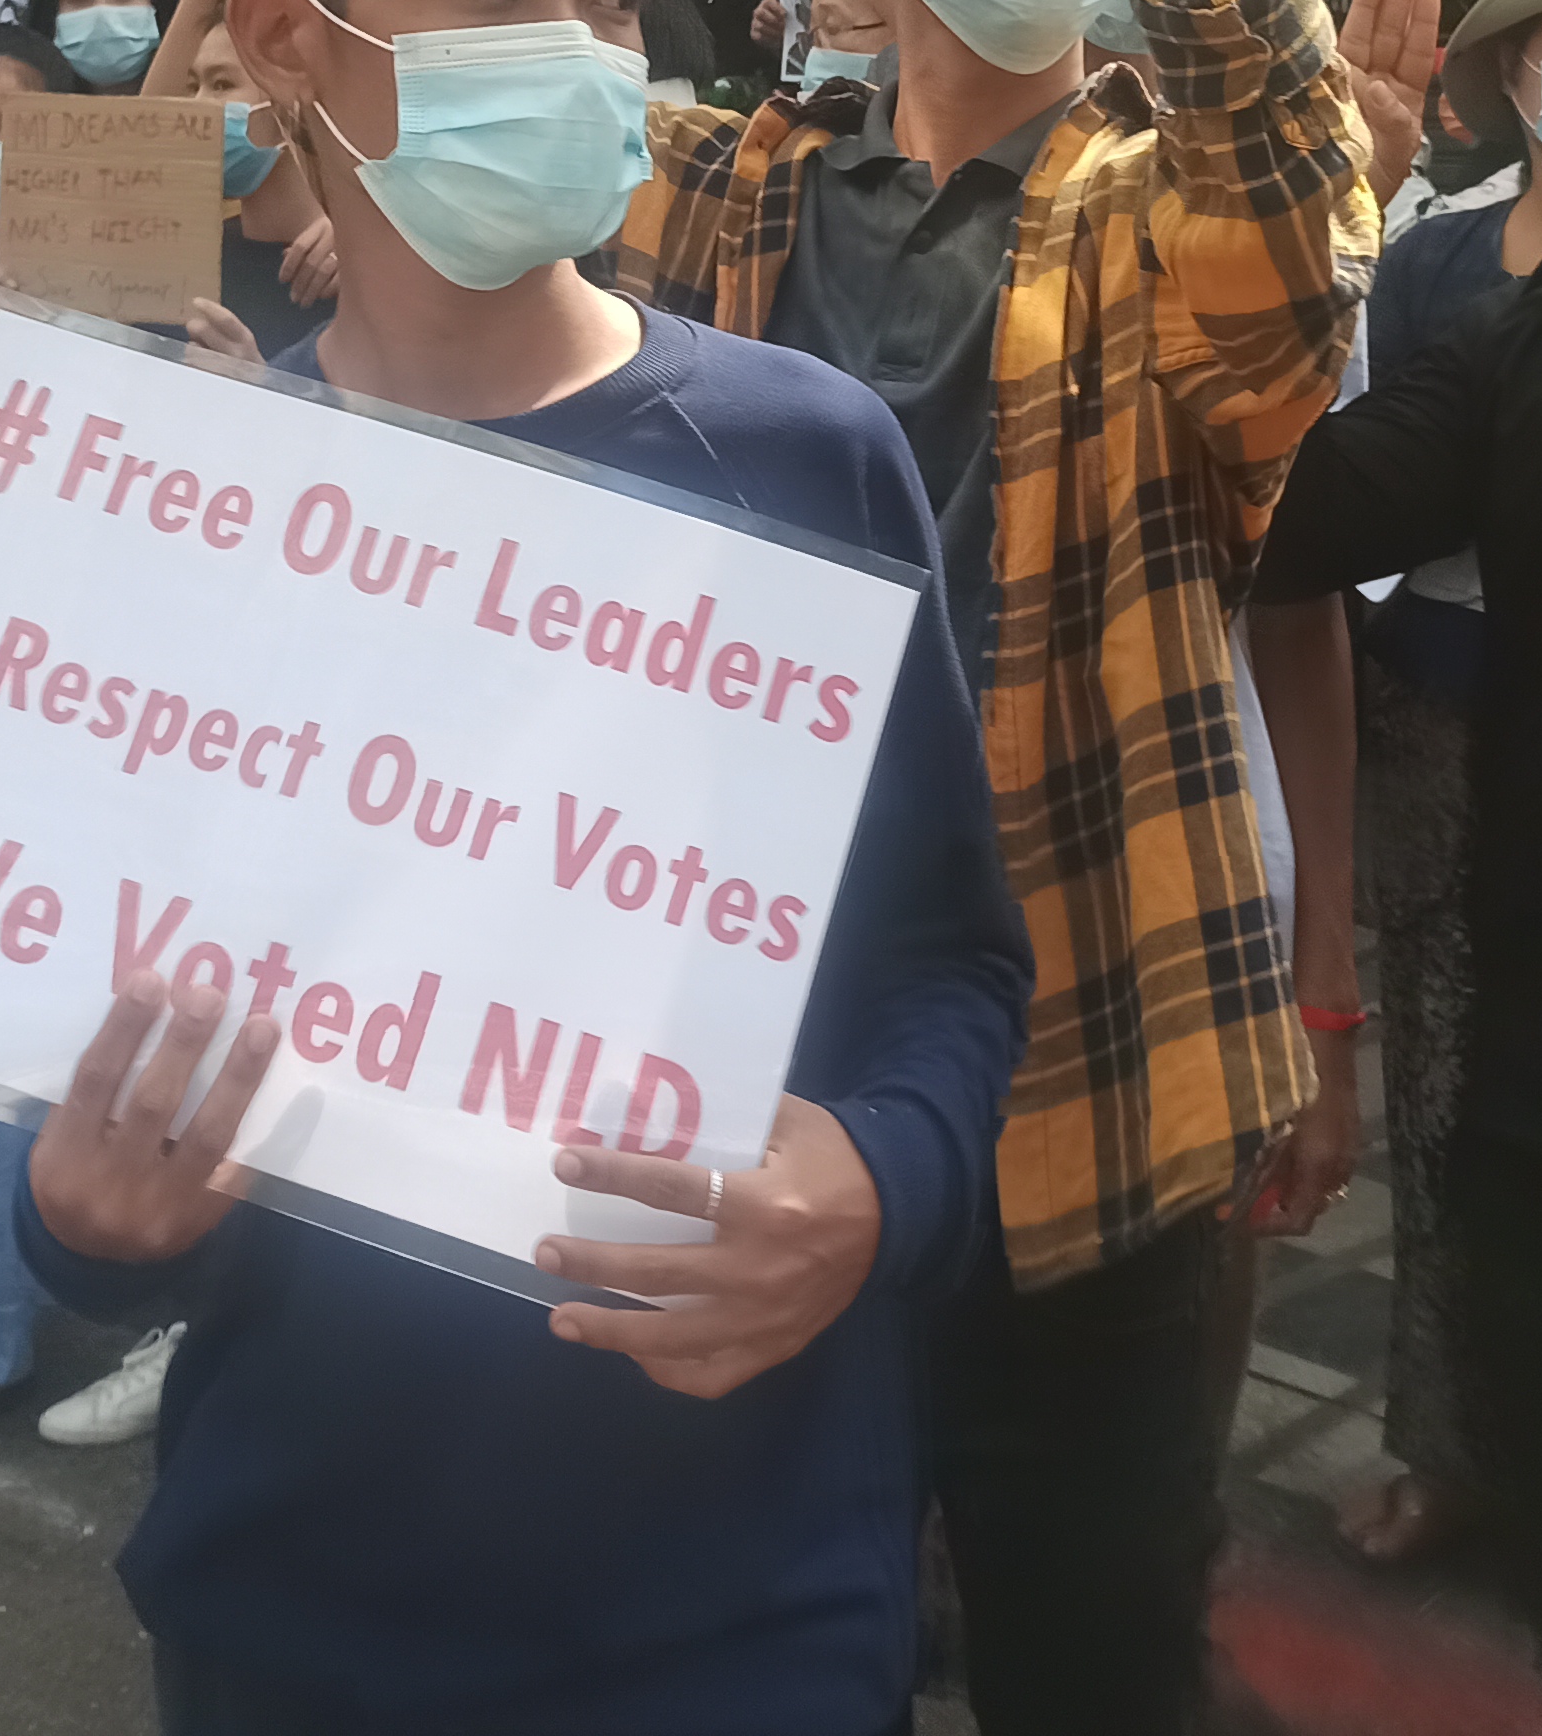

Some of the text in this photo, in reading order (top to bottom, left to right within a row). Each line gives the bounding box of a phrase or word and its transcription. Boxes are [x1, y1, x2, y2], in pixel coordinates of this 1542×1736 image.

[4, 166, 163, 199] HIGHER THAN
[10, 111, 214, 151] MY DREAMS ARE
[89, 215, 183, 245] HEIGHT
[59, 415, 254, 550] Free
[283, 483, 456, 607] Our
[476, 539, 861, 744] Leaders
[348, 735, 519, 861] Our
[554, 792, 807, 963] Votes
[112, 878, 443, 1092] Voted
[457, 1000, 703, 1163] NLD
